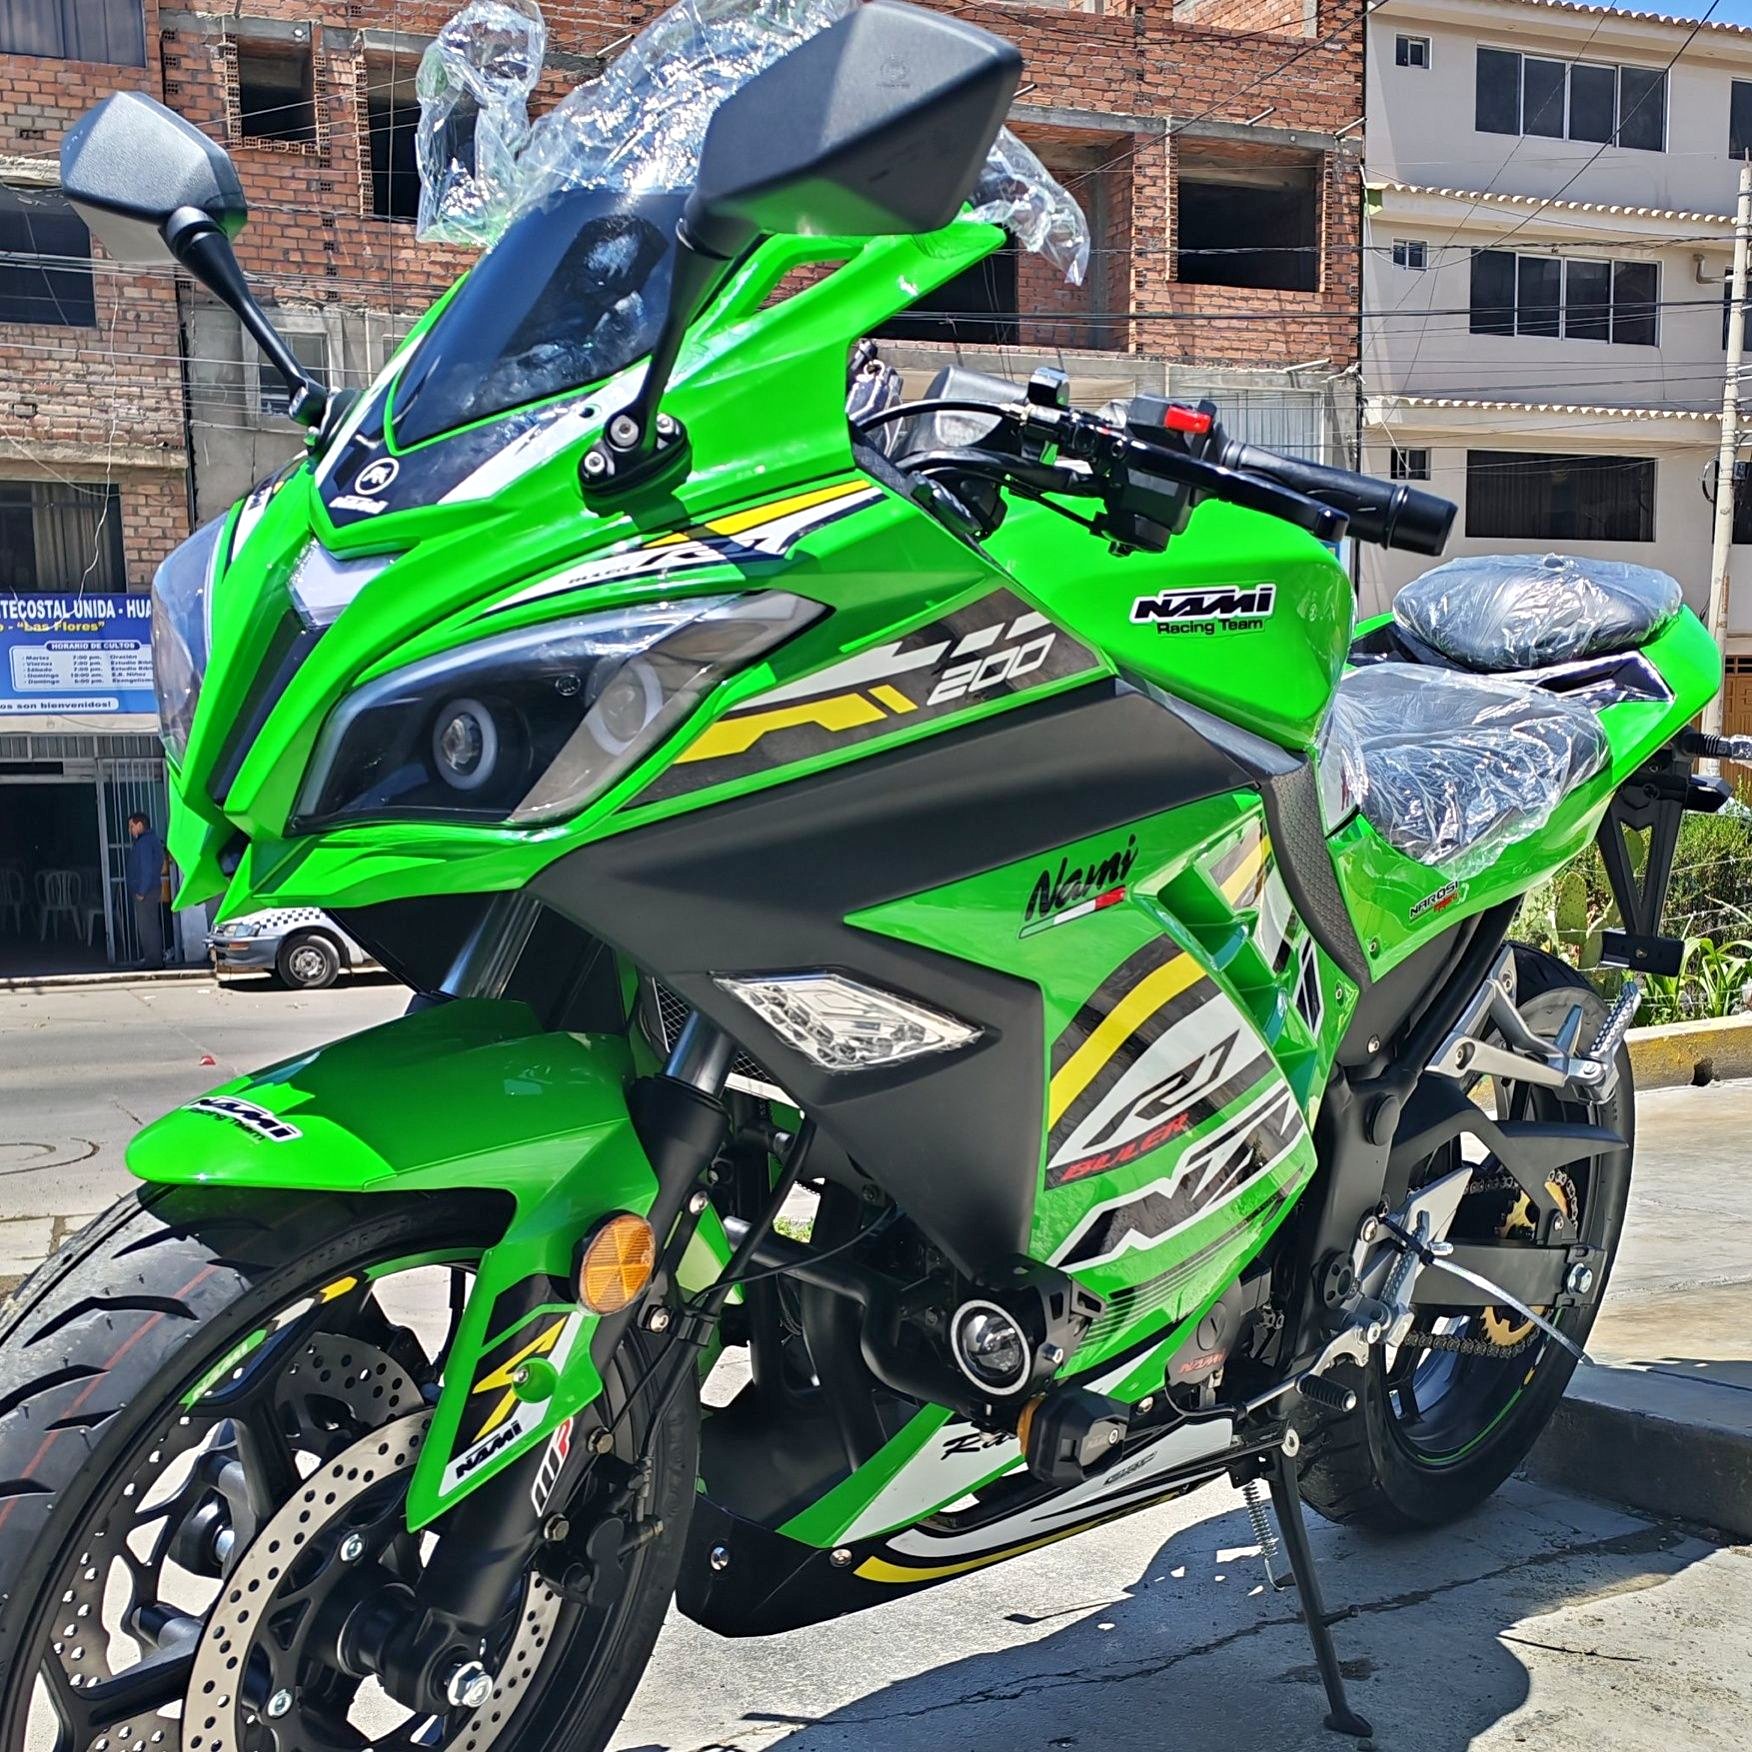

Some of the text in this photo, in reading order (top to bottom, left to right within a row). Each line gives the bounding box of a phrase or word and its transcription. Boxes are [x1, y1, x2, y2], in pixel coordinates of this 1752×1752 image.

[0, 599, 70, 619] TECOSTAL
[73, 599, 116, 619] UNIDA
[1157, 618, 1264, 635] Racing Team
[51, 642, 135, 650] HORARIO DE CULTOS
[926, 632, 1056, 707] 200
[40, 701, 112, 709] bienvenidos!
[1410, 880, 1459, 918] NAROSI
